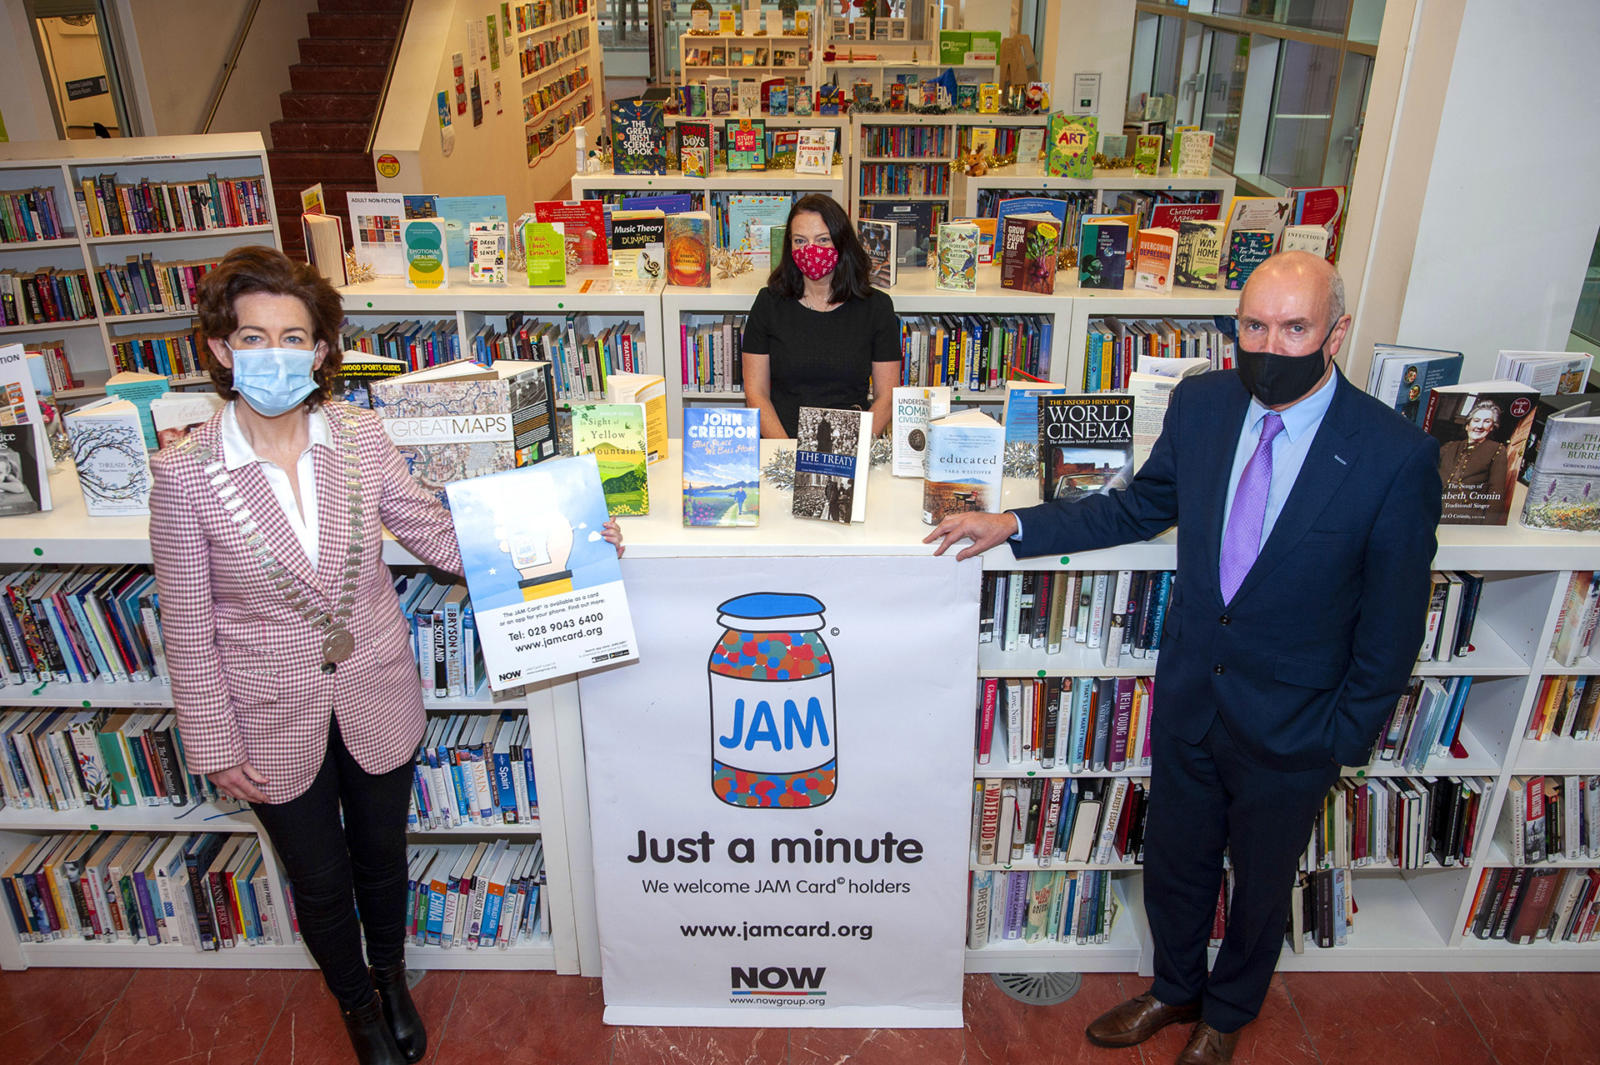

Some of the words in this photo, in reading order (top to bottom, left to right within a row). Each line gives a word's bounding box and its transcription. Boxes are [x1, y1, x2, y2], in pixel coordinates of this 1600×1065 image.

[626, 127, 652, 135] GREAT
[629, 134, 650, 142] IRISH
[624, 140, 655, 149] SCIENCE
[682, 135, 705, 148] BOYS
[1058, 132, 1087, 145] ART
[628, 148, 653, 156] BOOK
[1169, 207, 1204, 217] Christmas
[614, 225, 636, 234] Music
[637, 224, 663, 234] Theory
[1008, 226, 1025, 234] GROW
[622, 235, 656, 245] DUMMIES
[1008, 234, 1024, 243] COOK
[1200, 239, 1217, 248] WAY
[1007, 242, 1018, 250] EAT
[1197, 248, 1218, 258] HOME
[1140, 249, 1172, 260] DEPRESSION
[703, 413, 742, 426] JOHN
[1048, 405, 1132, 422] WORLD
[588, 416, 611, 428] Sight
[591, 430, 626, 440] Yellow
[688, 425, 757, 439] CREEDON
[1046, 422, 1132, 440] CINEMA
[588, 446, 636, 457] Mountain
[800, 452, 819, 462] THE
[823, 454, 855, 467] TREATY
[939, 455, 997, 465] educated
[1442, 492, 1466, 500] abeth
[1470, 492, 1501, 500] Cronin
[550, 598, 573, 608] available
[515, 616, 526, 625] app
[535, 611, 547, 620] your
[568, 603, 580, 612] Find
[448, 612, 457, 648] BRYSON
[508, 632, 525, 642] Tel:
[528, 624, 547, 638] 028
[550, 619, 575, 632] 9043
[579, 612, 603, 626] 6400
[434, 624, 444, 662] SCOTLAND
[515, 626, 603, 654] www.jamcard.org
[499, 670, 521, 681] NOW
[1120, 692, 1131, 710] NEIL
[719, 697, 830, 751] JAM
[1116, 711, 1128, 736] YOUNG
[475, 764, 486, 792] SPAIN
[498, 766, 510, 790] Spain
[981, 788, 1000, 840] WATERLOO
[1106, 811, 1118, 831] ESCAPE
[627, 830, 714, 864] Just
[728, 838, 755, 864] a
[771, 829, 923, 864] minute
[642, 879, 669, 894] We
[674, 879, 750, 894] welcome
[754, 879, 791, 894] JAM
[848, 879, 910, 894] holders
[476, 880, 486, 908] SOUTHEAST
[431, 892, 444, 922] CHINA
[445, 893, 456, 923] CHINA
[975, 888, 988, 931] DRESDEN
[1010, 903, 1018, 931] CAMPBELL
[680, 921, 872, 941] www.jamcard.org
[731, 967, 826, 988] NOW
[729, 997, 825, 1007] www.nowgroup.org
